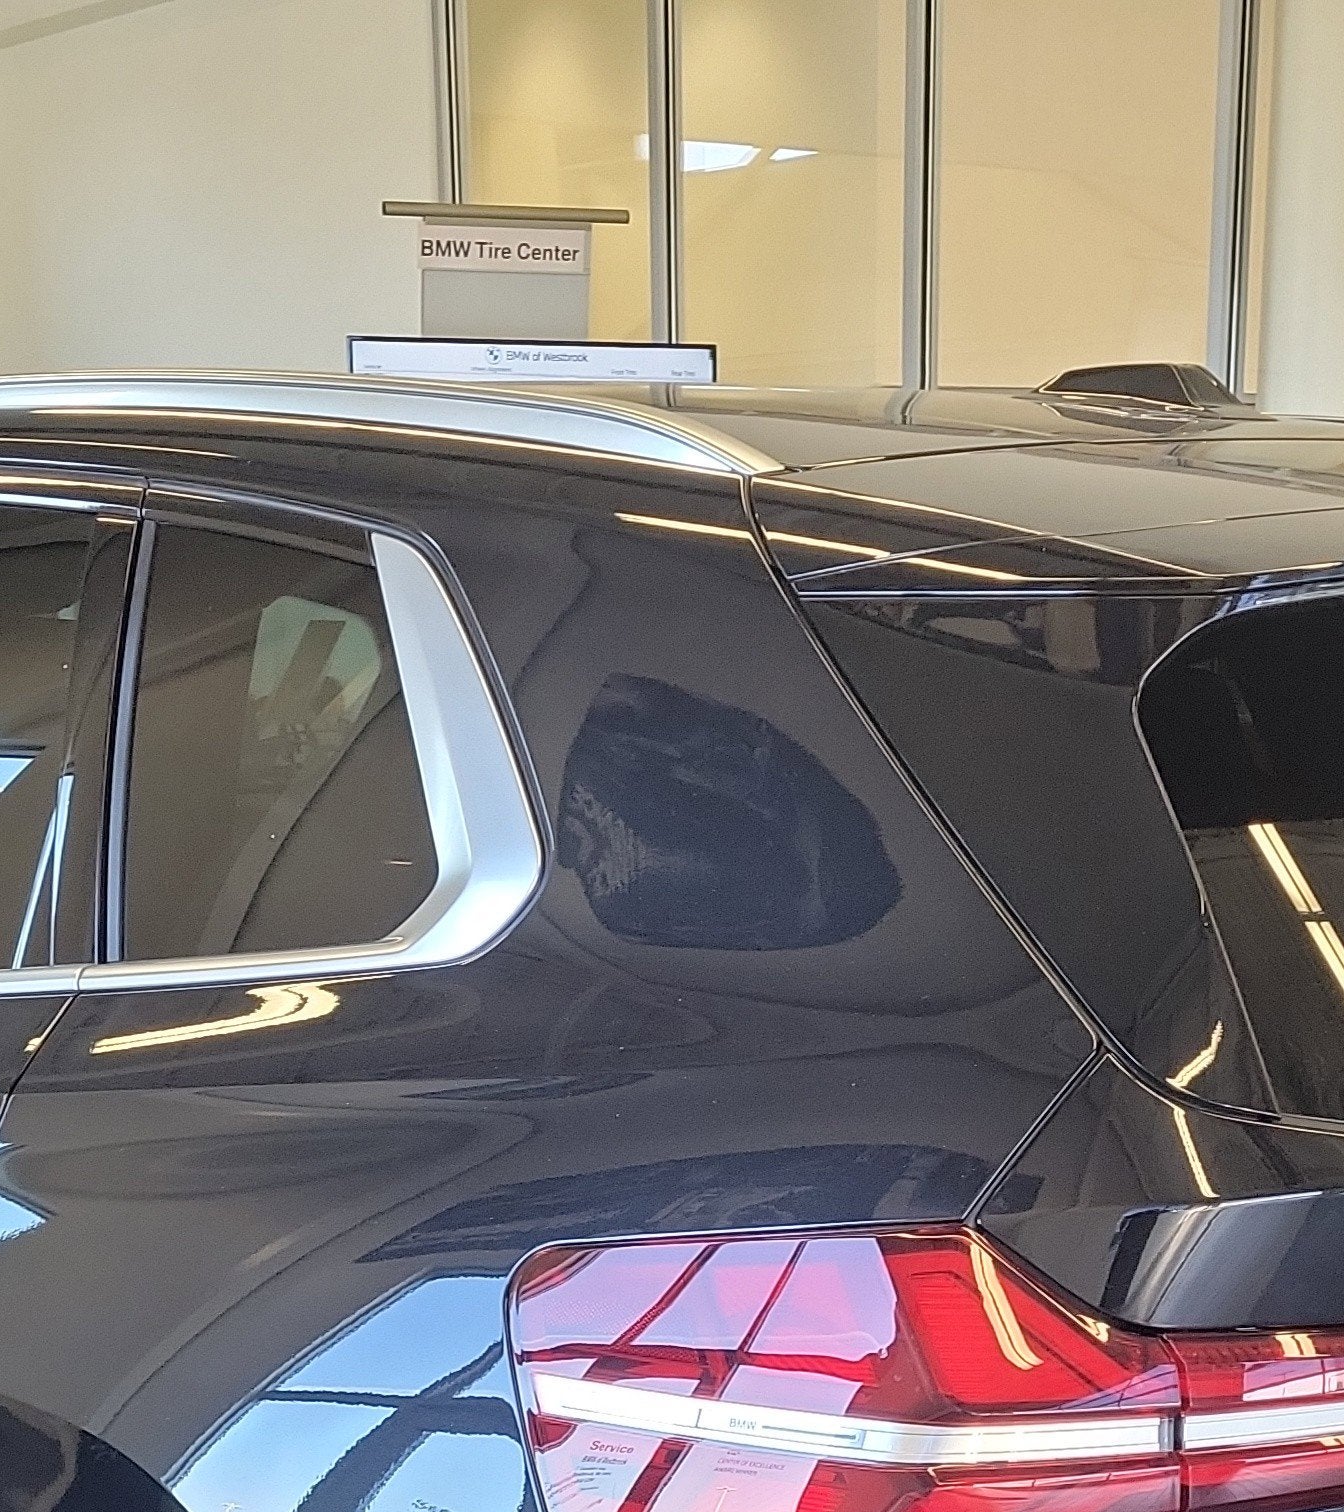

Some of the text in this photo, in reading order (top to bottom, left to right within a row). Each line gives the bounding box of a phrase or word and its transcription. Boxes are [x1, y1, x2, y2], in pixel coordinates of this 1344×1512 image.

[421, 239, 580, 262] BMW Tire Center
[729, 1417, 757, 1430] BMW
